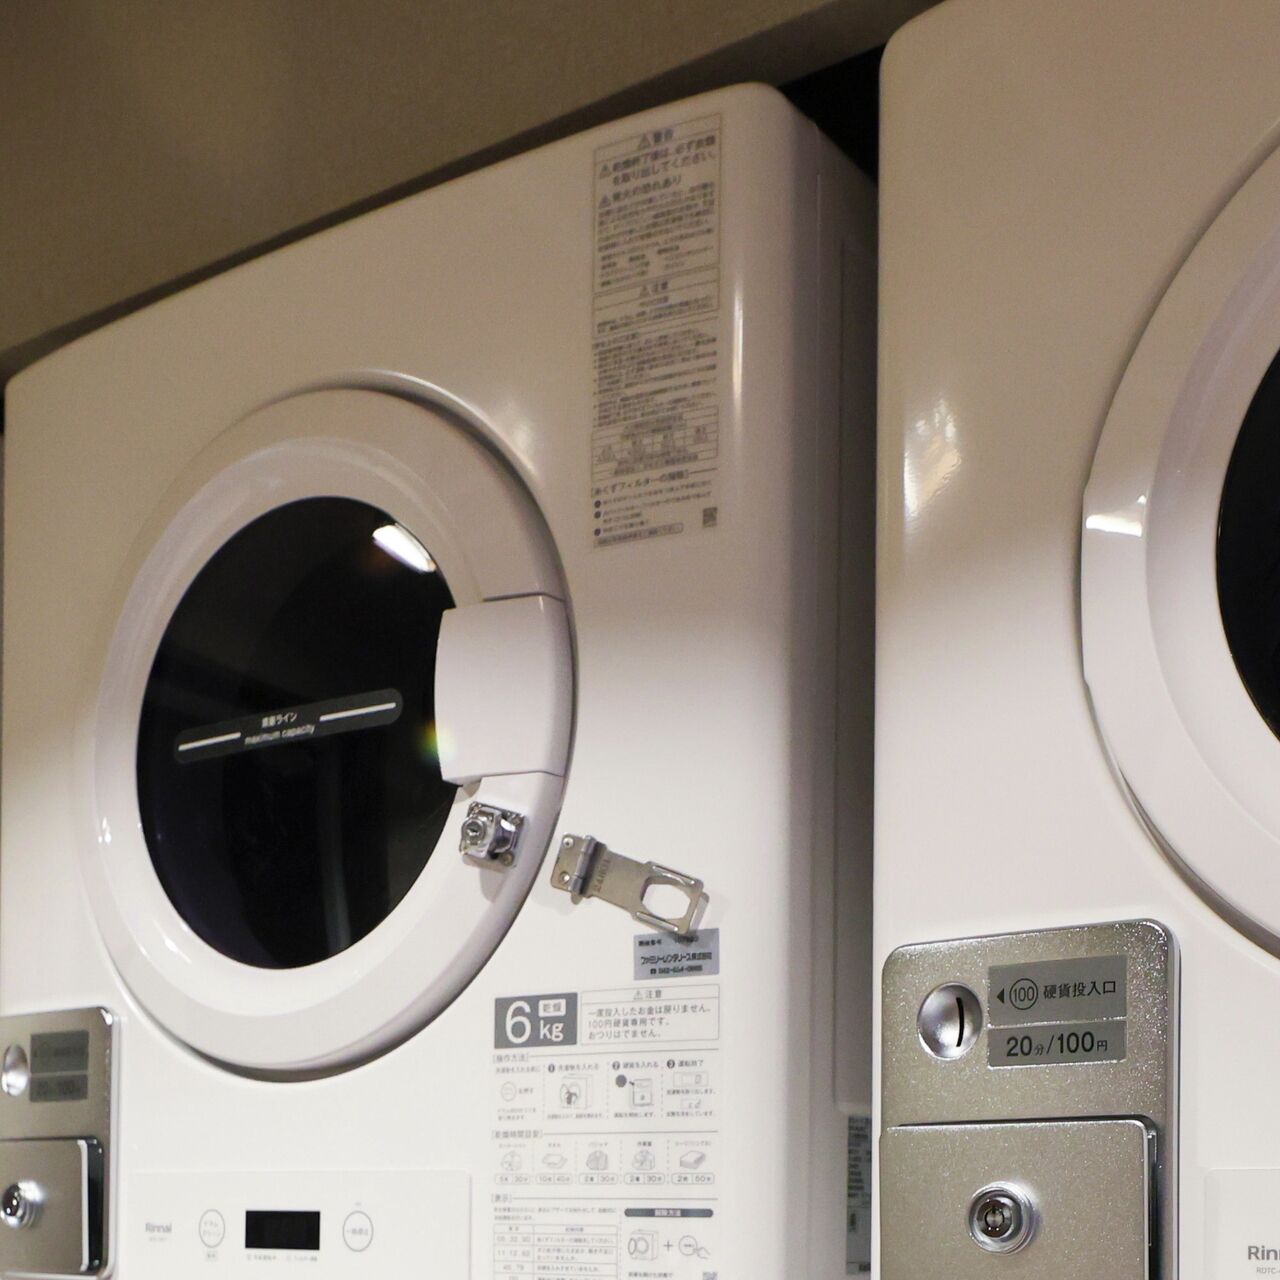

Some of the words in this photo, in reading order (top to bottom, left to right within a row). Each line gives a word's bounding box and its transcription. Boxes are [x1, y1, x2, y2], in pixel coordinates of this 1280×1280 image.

[1043, 980, 1117, 1000] 硬貨投入口
[505, 1001, 531, 1044] 6
[539, 1020, 564, 1042] kg
